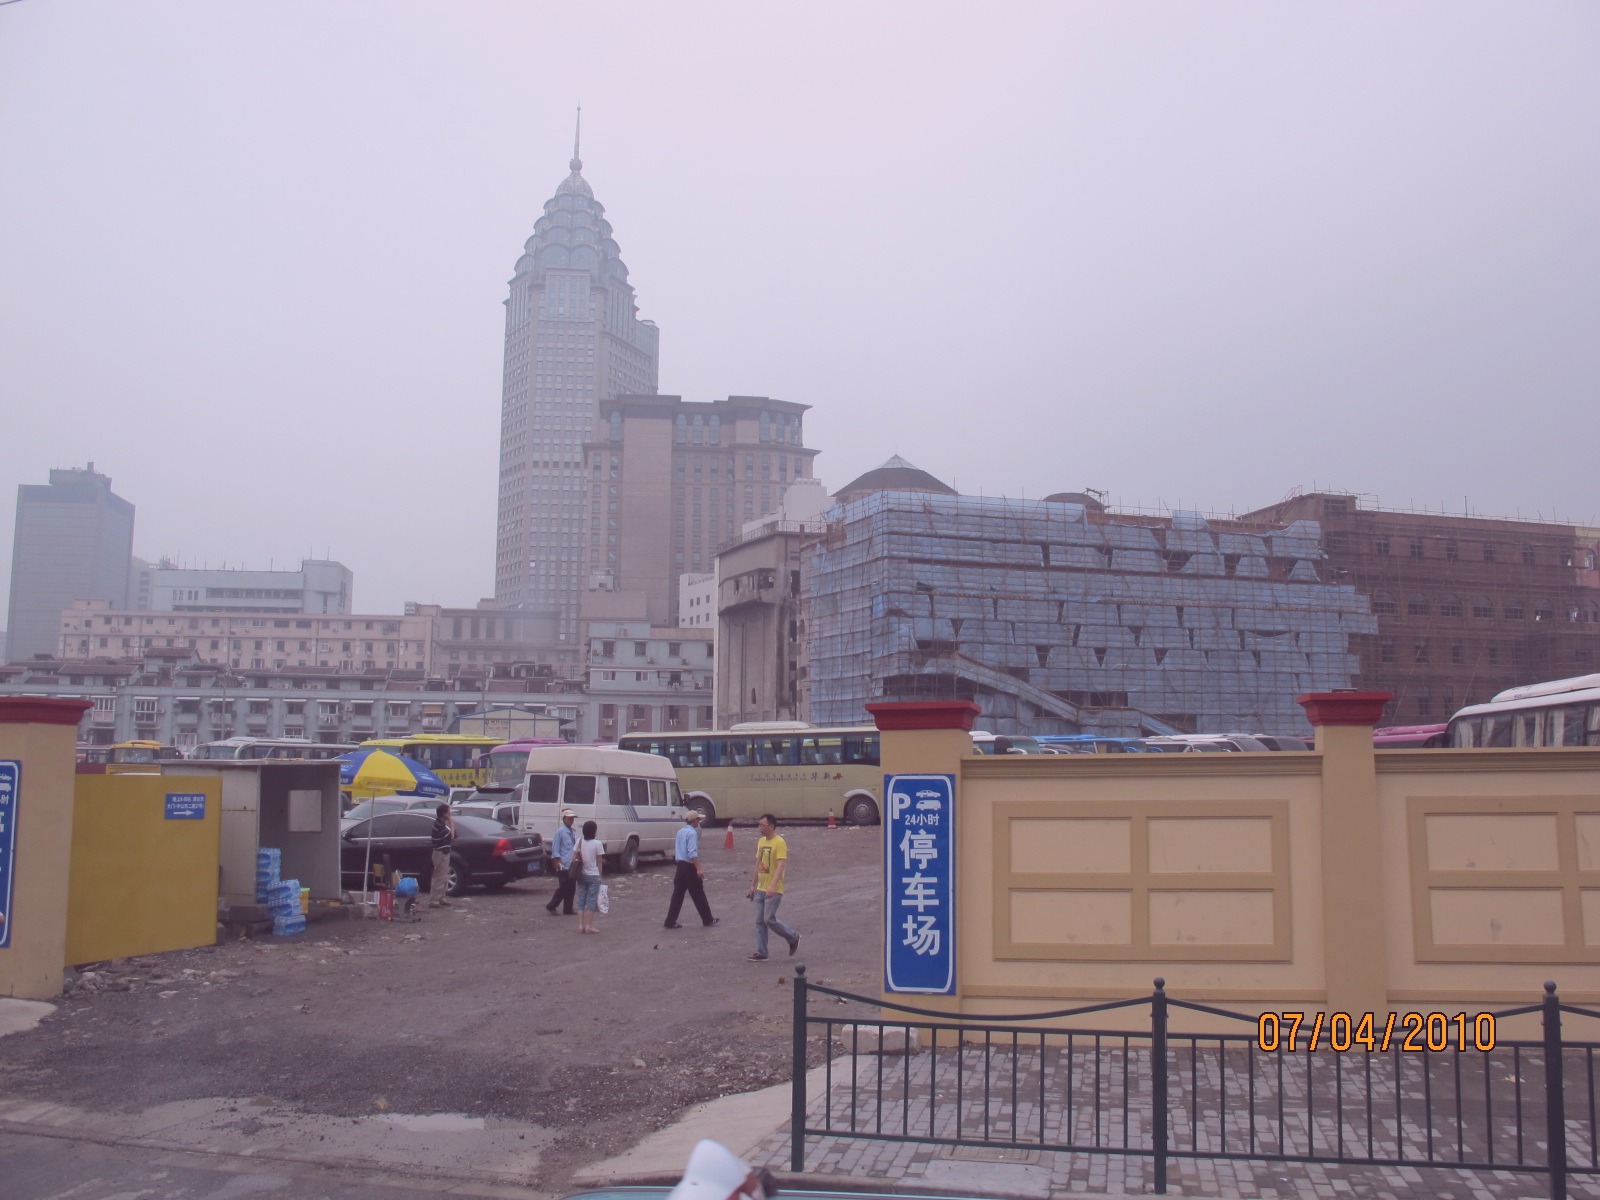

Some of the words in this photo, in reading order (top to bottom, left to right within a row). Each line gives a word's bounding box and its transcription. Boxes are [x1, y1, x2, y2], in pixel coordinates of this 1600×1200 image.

[892, 792, 911, 820] P
[904, 813, 940, 826] 24小时
[899, 828, 941, 956] 停车场
